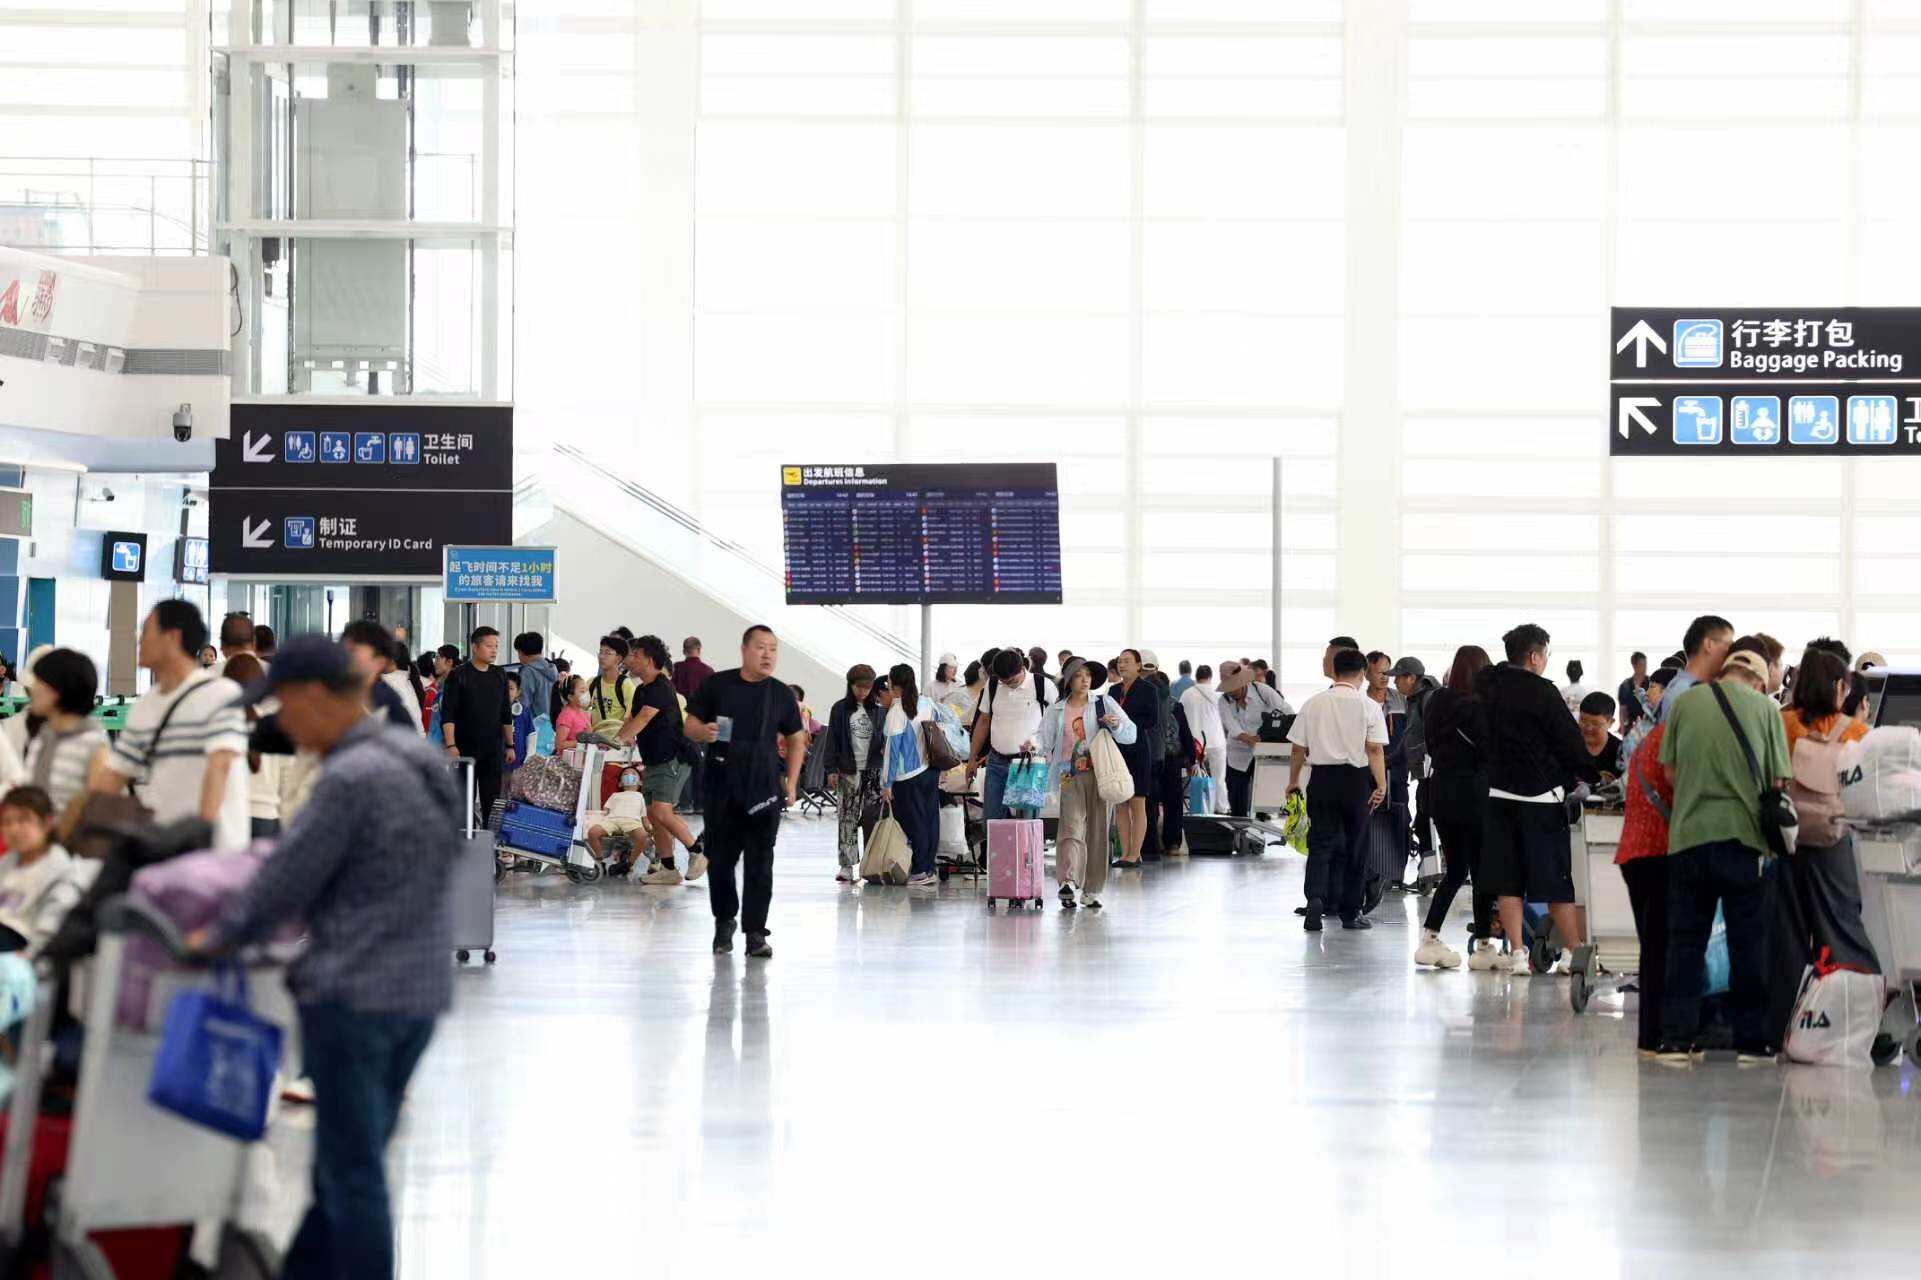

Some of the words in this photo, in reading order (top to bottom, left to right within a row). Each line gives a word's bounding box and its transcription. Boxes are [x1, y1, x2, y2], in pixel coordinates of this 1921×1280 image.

[1731, 319, 1855, 348] 行李打包
[1731, 350, 1818, 373] Baggage
[1823, 350, 1903, 373] Packing
[424, 433, 473, 451] 卫生间
[424, 453, 460, 465] Toilet
[803, 466, 865, 478] 出发航班信息
[319, 517, 357, 537] 制证
[319, 538, 386, 551] Temporary
[388, 538, 400, 549] ID
[403, 538, 433, 549] Card
[449, 561, 552, 574] 起飞时间不足1小时
[458, 574, 543, 587] 的旅客请来找我
